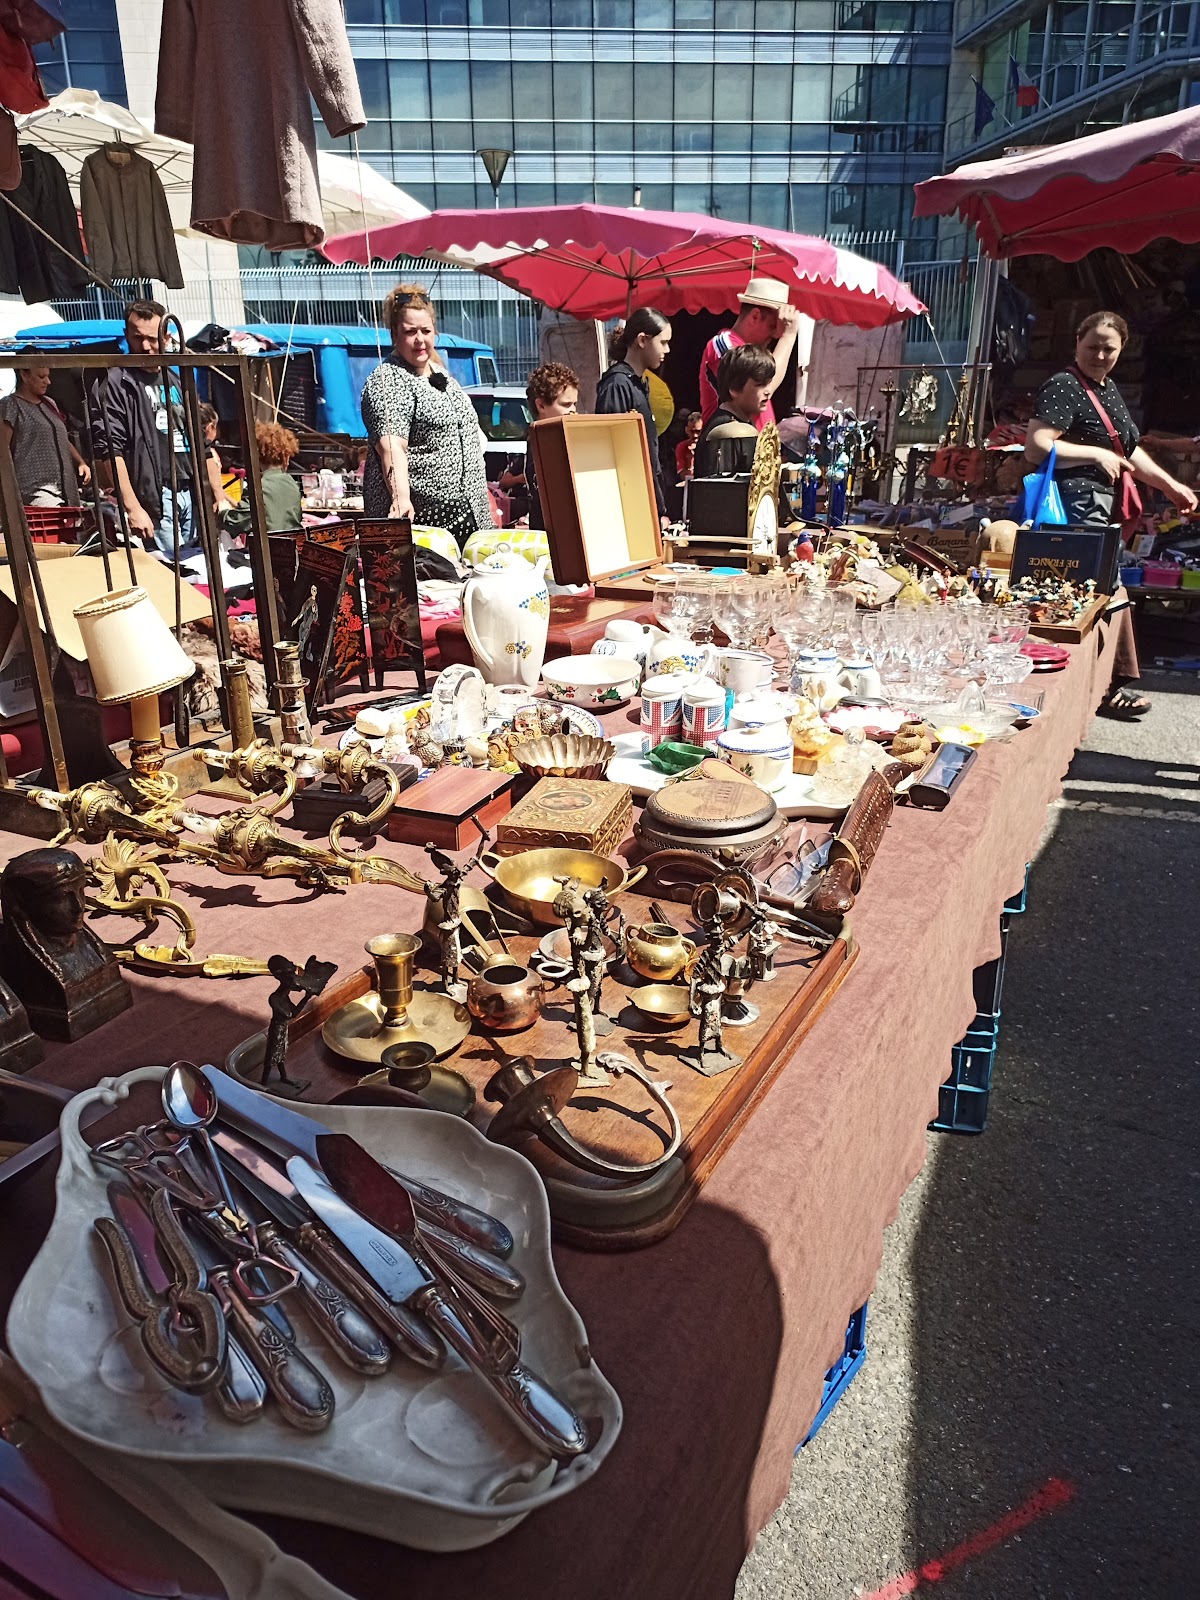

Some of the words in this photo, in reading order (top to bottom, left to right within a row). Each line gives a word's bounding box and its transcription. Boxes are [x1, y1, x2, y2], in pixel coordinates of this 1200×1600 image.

[942, 453, 970, 477] 1€
[927, 536, 971, 548] Banane
[1028, 557, 1065, 567] FRANCE
[1066, 559, 1079, 568] DE
